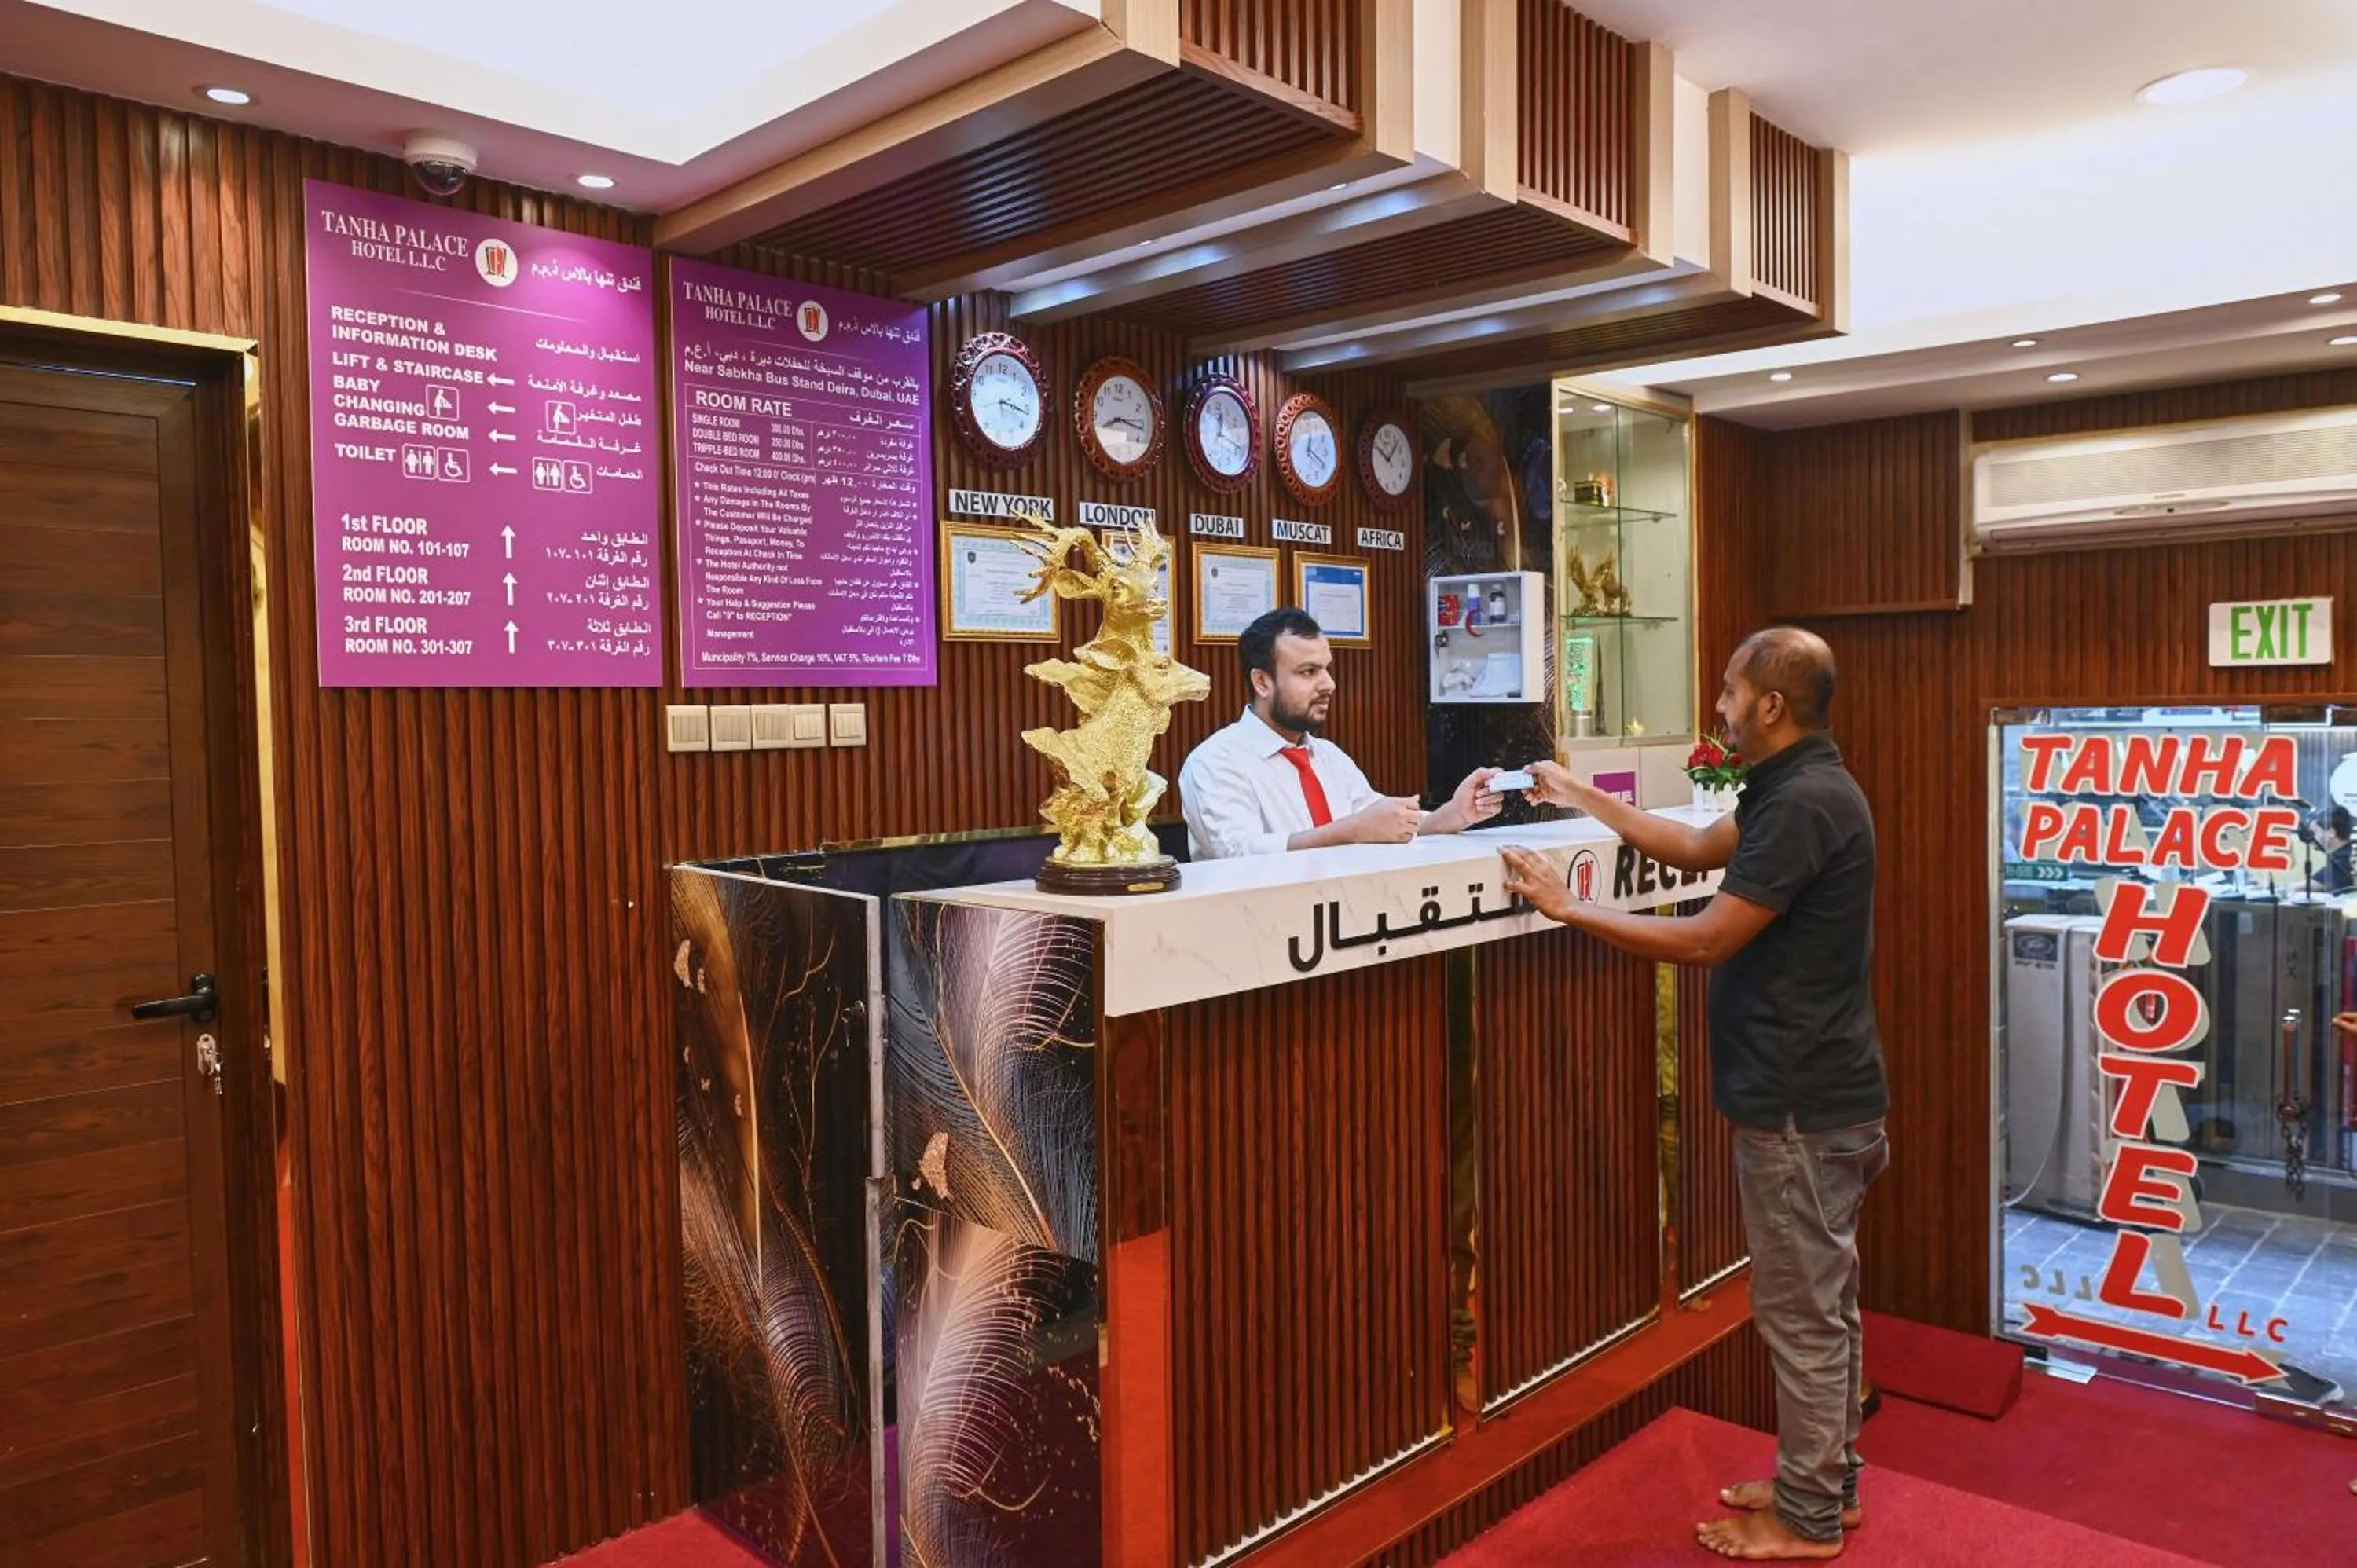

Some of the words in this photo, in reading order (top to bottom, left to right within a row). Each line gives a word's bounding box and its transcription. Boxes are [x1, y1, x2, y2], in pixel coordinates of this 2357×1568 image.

[322, 211, 390, 244] TANHA
[395, 225, 469, 258] PALACE
[351, 240, 405, 265] HOTEL
[684, 281, 733, 308] TANHA
[739, 291, 793, 317] PALACE
[332, 306, 428, 335] RECEPTION
[436, 321, 445, 335] &
[705, 306, 745, 325] HOTEL
[332, 325, 449, 354] INFORMATION
[454, 343, 497, 362] DESK
[333, 351, 369, 371] LIFT
[376, 357, 388, 372] &
[393, 360, 484, 384] STAIRCASE
[999, 363, 1008, 374] 12
[333, 375, 380, 393] BABY
[684, 359, 713, 375] Near
[717, 365, 762, 382] Sabkha
[766, 372, 788, 386] Bus
[791, 376, 824, 390] Stand
[896, 393, 919, 407] UAE
[334, 394, 426, 417] CHANGING
[695, 390, 746, 411] ROOM
[750, 397, 792, 416] RATE
[334, 412, 416, 434] GARBAGE
[421, 423, 470, 440] ROOM
[692, 412, 717, 427] SINGLE
[720, 416, 740, 428] ROOM
[692, 427, 721, 441] DOUBLE
[723, 431, 737, 442] BED
[739, 433, 760, 445] ROOM
[335, 443, 396, 463] TOILET
[740, 447, 760, 459] ROOM
[695, 461, 718, 474] Check
[720, 463, 733, 475] Out
[735, 466, 752, 477] Time
[780, 471, 800, 482] Clock
[720, 483, 742, 493] Rates
[789, 489, 809, 500] Taxes
[703, 495, 719, 505] Any
[720, 496, 750, 507] Damage
[761, 499, 773, 509] The
[775, 500, 800, 511] Rooms
[801, 503, 811, 513] By
[955, 492, 998, 514] NEW
[1003, 496, 1051, 518] YORK
[341, 513, 368, 532] 1st
[372, 515, 428, 535] FLOOR
[703, 507, 718, 517] The
[719, 508, 755, 519] Customer
[783, 514, 813, 526] Charged
[1085, 504, 1154, 526] LONDON
[703, 519, 728, 530] Please
[760, 524, 777, 534] Your
[1194, 515, 1239, 535] DUBAI
[1277, 522, 1329, 542] MUSCAT
[342, 537, 387, 555] ROOM
[389, 539, 414, 555] NO.
[417, 540, 470, 558] 101-107
[1361, 529, 1402, 548] AFRICA
[705, 546, 742, 557] Reception
[753, 548, 775, 559] Check
[786, 551, 803, 560] Time
[342, 565, 372, 583] 2nd
[376, 566, 428, 584] FLOOR
[706, 559, 720, 568] The
[721, 559, 740, 570] Hotel
[741, 561, 775, 573] Authority
[706, 572, 747, 584] Responsible
[749, 574, 762, 584] Any
[763, 575, 779, 584] Kind
[343, 587, 387, 603] ROOM
[391, 588, 416, 604] NO.
[419, 589, 471, 606] 201-207
[721, 585, 744, 595] Room
[706, 598, 724, 607] Your
[725, 598, 742, 608] Help
[751, 599, 790, 610] Suggestion
[706, 610, 722, 620] Call
[344, 616, 370, 633] 3rd
[375, 617, 428, 634] FLOOR
[706, 628, 754, 639] Management
[2231, 603, 2313, 660] EXIT
[346, 638, 388, 654] ROOM
[392, 639, 417, 654] NO.
[420, 639, 473, 654] 301-307
[761, 652, 788, 663] Service
[790, 653, 815, 665] Charge
[834, 653, 848, 663] VAT
[2020, 735, 2299, 799] TANHA
[2020, 804, 2300, 871] PALACE
[1613, 844, 1707, 900] REC
[2094, 881, 2212, 1320] HOTEL
